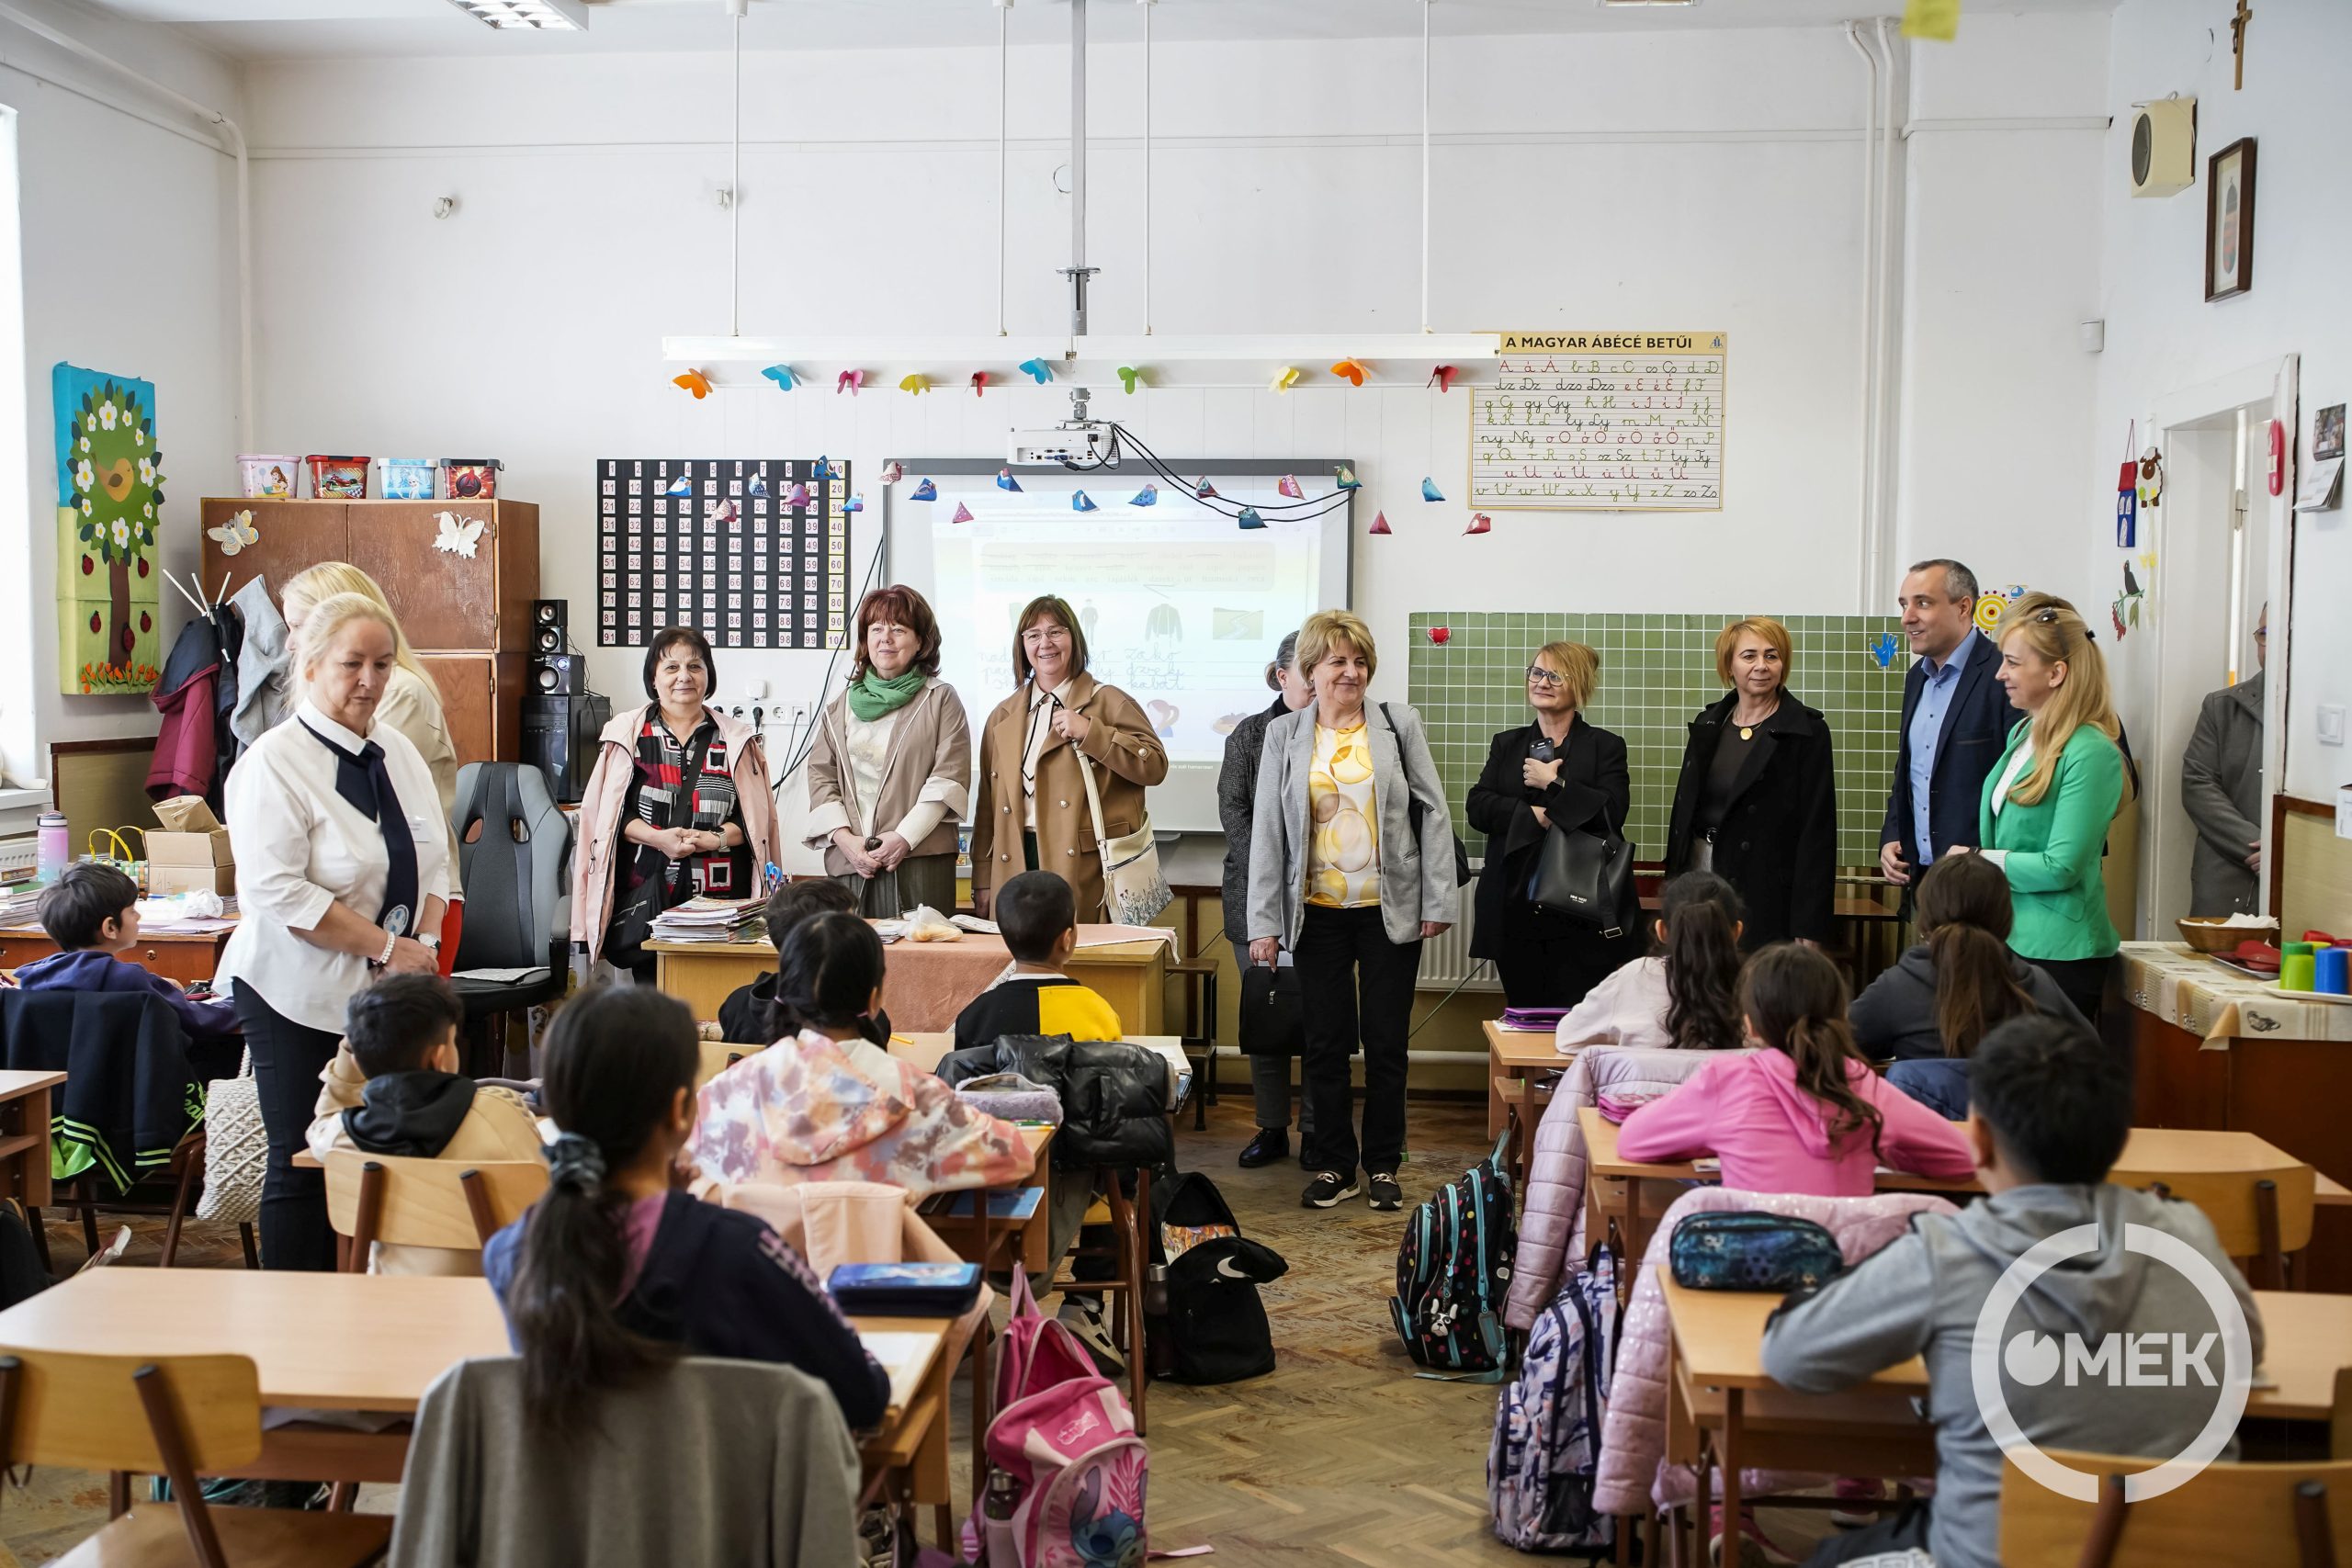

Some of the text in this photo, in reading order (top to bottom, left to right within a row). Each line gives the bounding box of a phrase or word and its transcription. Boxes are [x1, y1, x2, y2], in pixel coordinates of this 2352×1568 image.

[1506, 334, 1691, 348] A MAGYAR ÁBÉCÉ BETŰI
[605, 483, 614, 492] 11
[630, 483, 640, 491] 12
[656, 483, 665, 491] 13
[706, 484, 716, 492] 15
[731, 484, 741, 492] 16
[781, 484, 792, 493] 18
[831, 484, 842, 493] 20
[604, 502, 614, 511] 21
[630, 502, 639, 511] 22
[655, 502, 665, 512] 23
[681, 502, 691, 511] 24
[755, 502, 765, 512] 27
[782, 503, 792, 512] 28
[808, 503, 817, 513] 29
[605, 521, 842, 531] 31 32 33 34 35 36 37 38 39 40
[605, 539, 842, 550] 41 42 43 44 45 46 47 48 49 50
[605, 558, 842, 570] 51 52 53 54 55 56 57 58 59 60
[605, 577, 842, 588] 61 62 63 64 65 66 67 68 69 70
[605, 595, 842, 607] 71 72 73 74 75 76 77 78 79 80
[604, 614, 842, 626] 81 82 83 84 85 86 87 88 89 90
[605, 633, 614, 642] 91
[629, 633, 639, 642] 92
[729, 635, 740, 643] 96
[755, 636, 765, 644] 97
[780, 635, 790, 644] 98
[806, 636, 816, 644] 99
